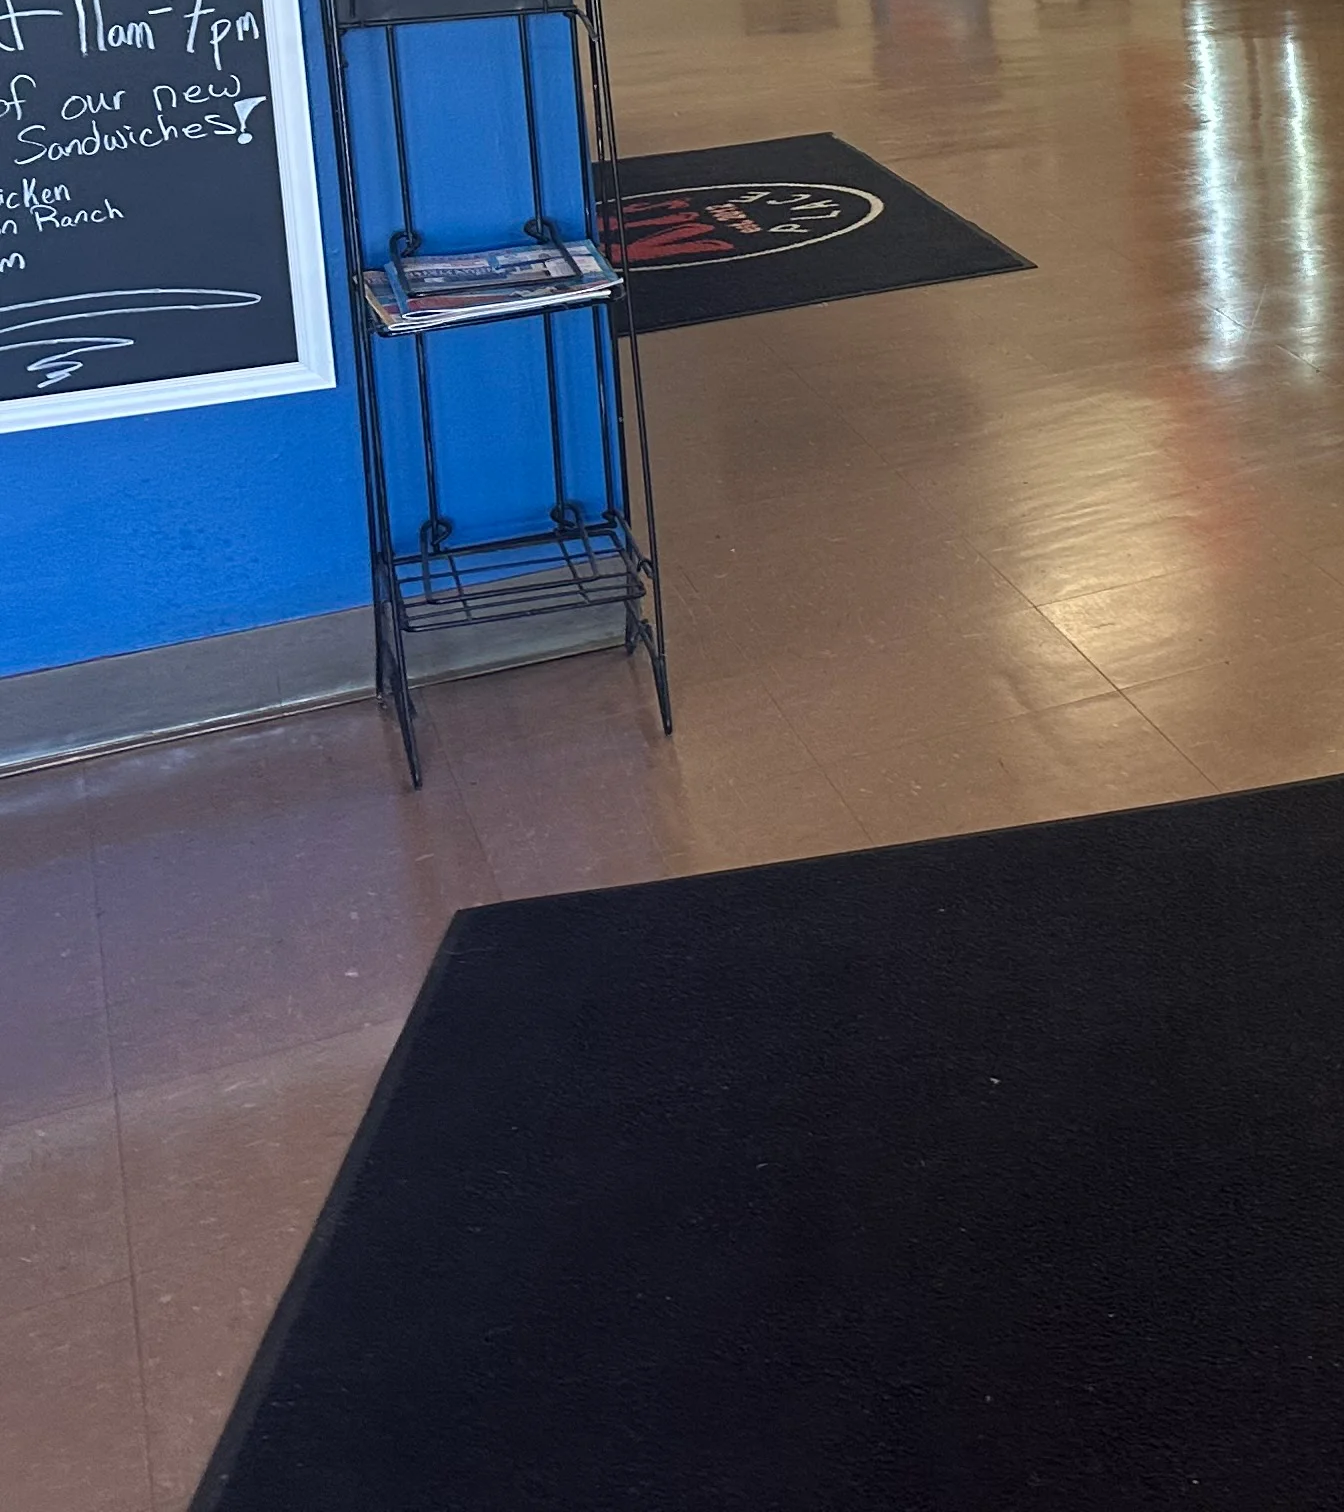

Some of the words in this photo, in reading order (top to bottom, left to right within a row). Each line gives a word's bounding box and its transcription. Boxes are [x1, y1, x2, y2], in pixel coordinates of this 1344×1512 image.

[60, 90, 126, 121] our
[152, 74, 241, 112] new
[30, 204, 125, 232] Ranch
[727, 191, 843, 234] PLACE
